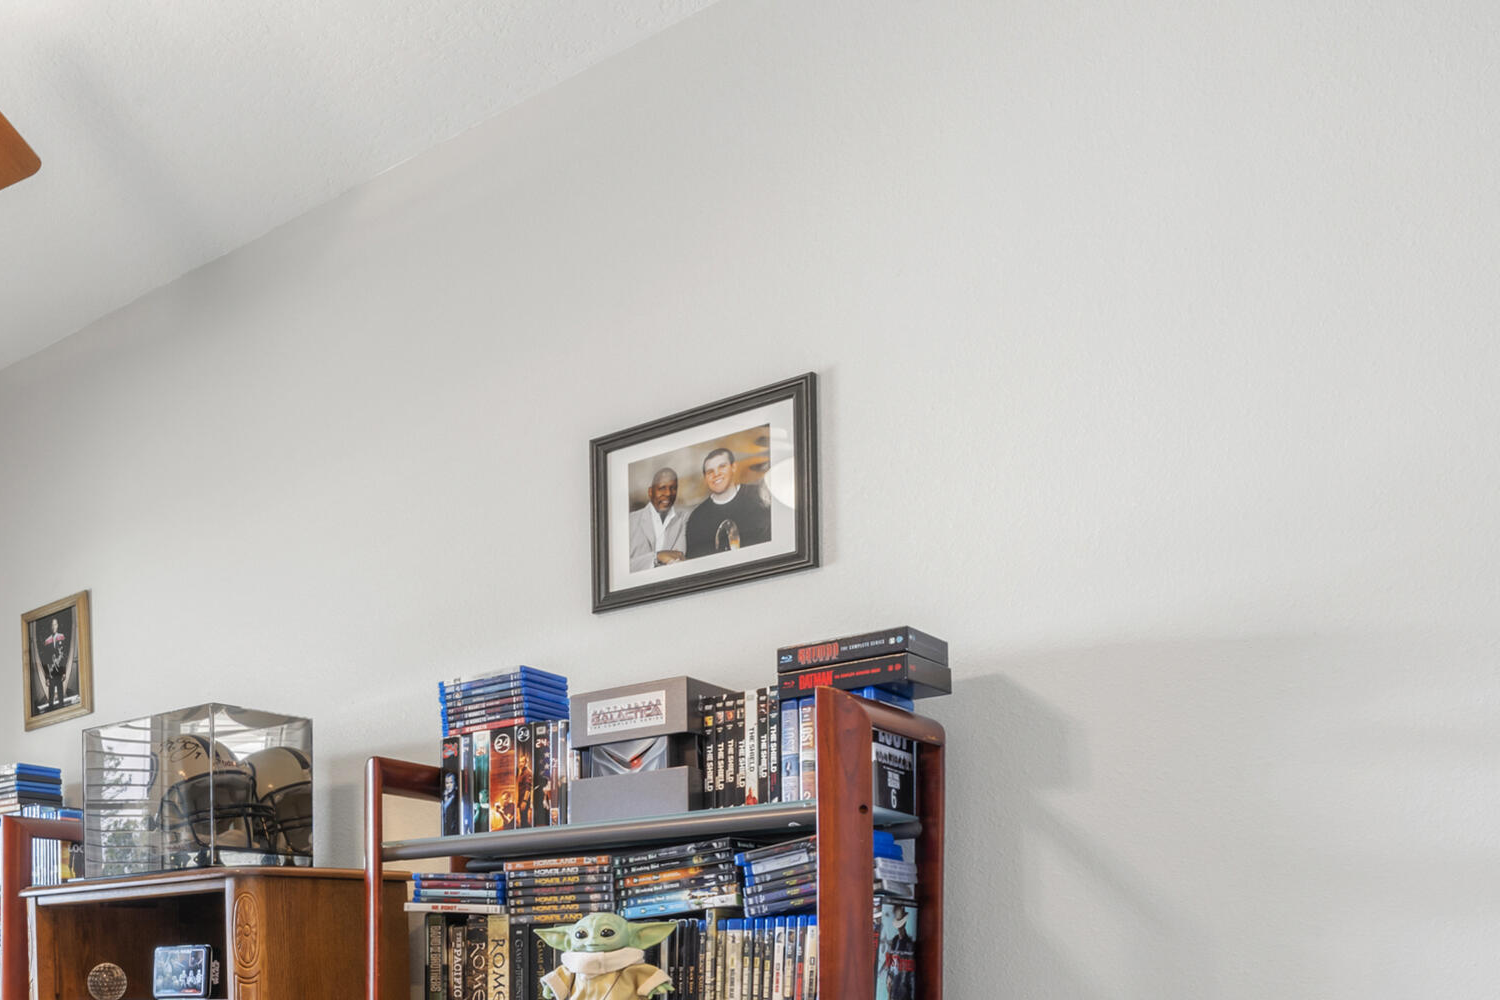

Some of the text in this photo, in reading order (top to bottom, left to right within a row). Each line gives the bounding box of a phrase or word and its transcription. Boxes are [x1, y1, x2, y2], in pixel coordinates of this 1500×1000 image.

[799, 670, 834, 690] BATMAN
[591, 704, 663, 726] GALACTICA
[495, 738, 510, 748] 24
[518, 730, 529, 739] 24
[535, 739, 548, 748] 24
[802, 722, 814, 747] LOST
[890, 788, 897, 809] 6
[515, 939, 523, 963] GAME
[453, 948, 462, 998] PACIFIC
